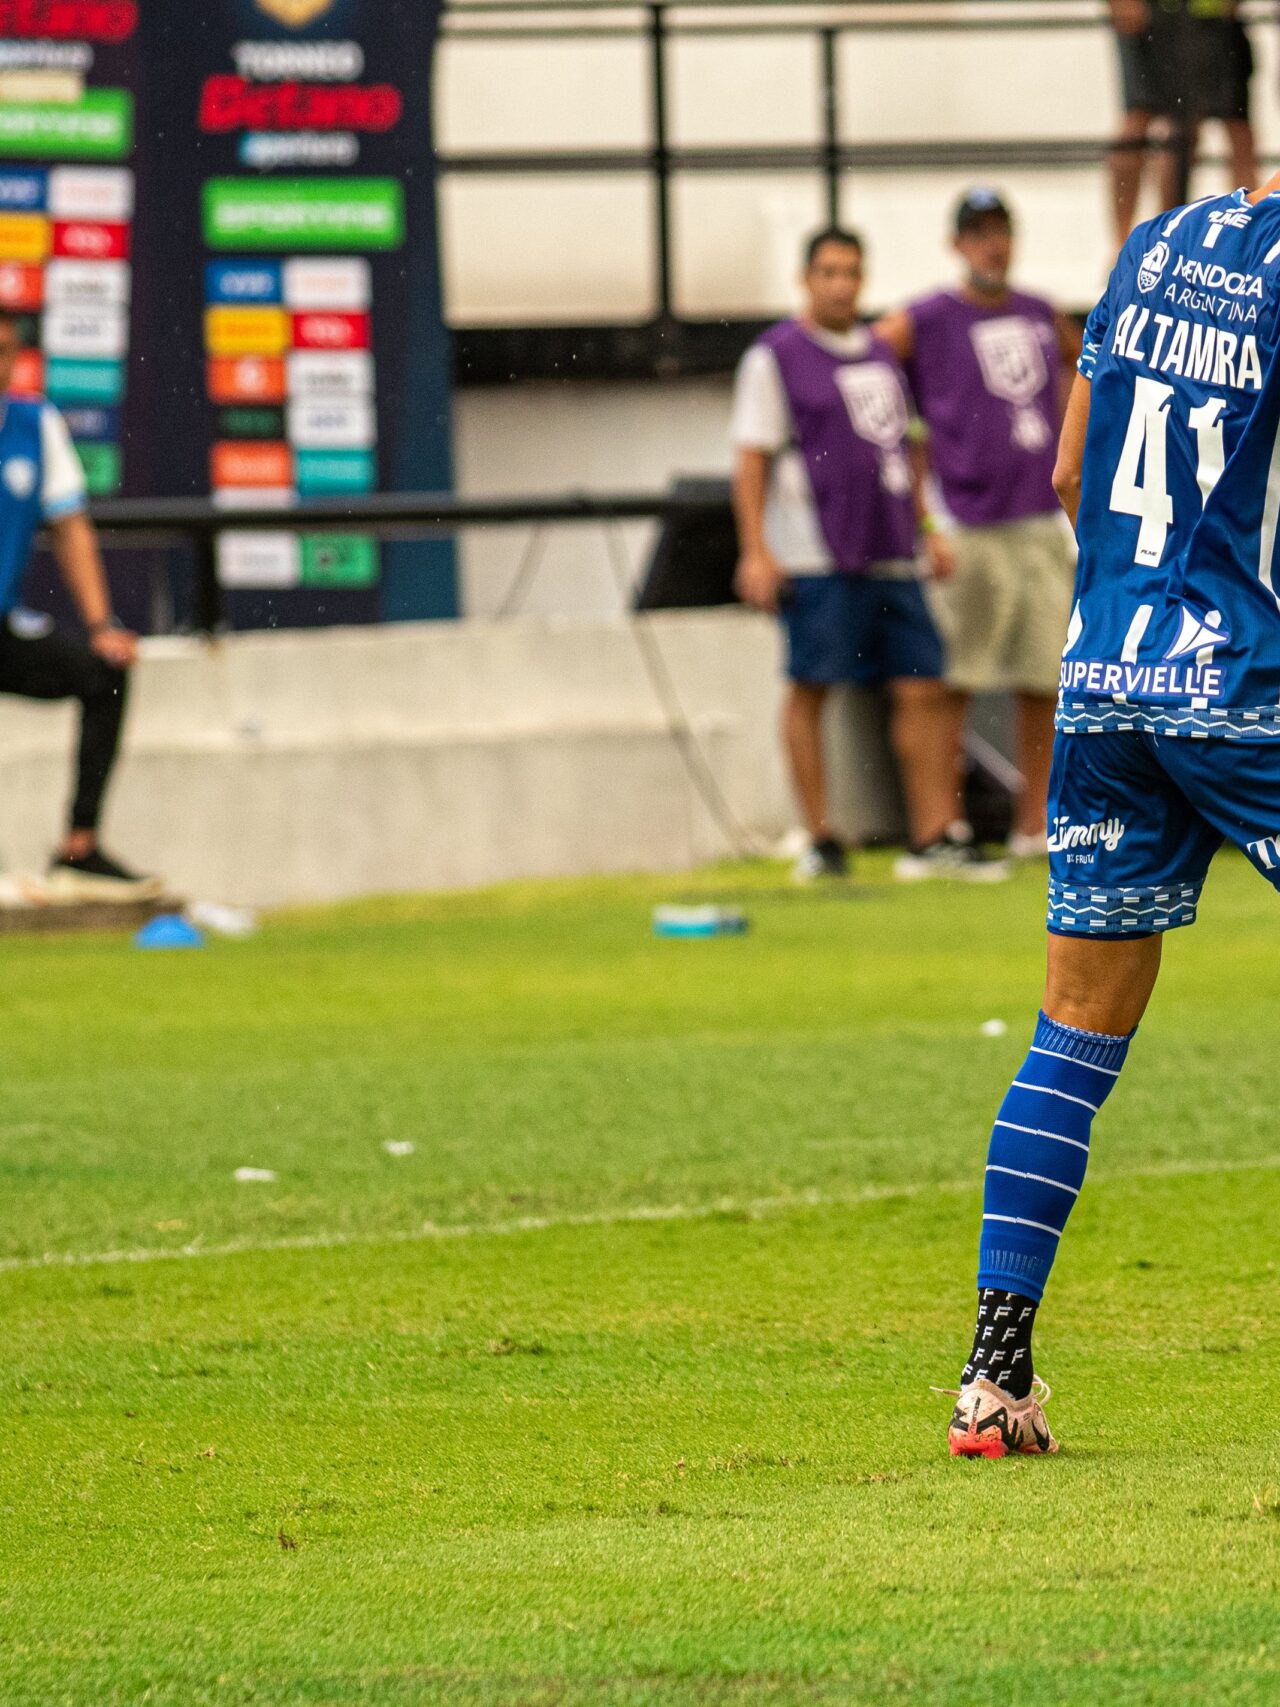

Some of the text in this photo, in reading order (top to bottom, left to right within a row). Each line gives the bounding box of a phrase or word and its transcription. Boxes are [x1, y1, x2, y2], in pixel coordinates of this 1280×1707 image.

[1172, 254, 1263, 299] MENDOZA
[1111, 304, 1262, 390] ALTAMRA
[1109, 376, 1227, 568] 41
